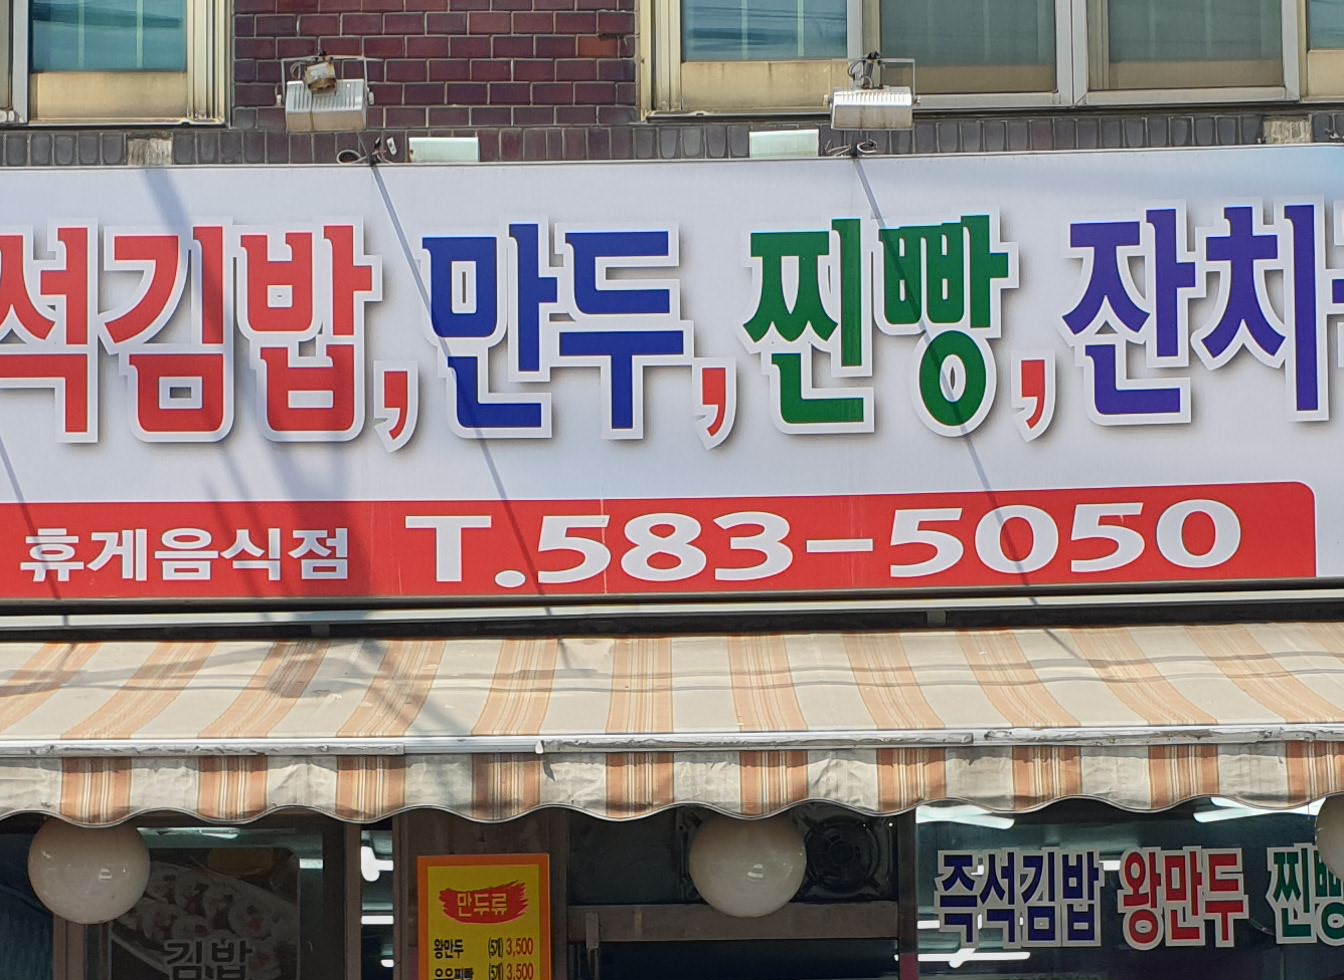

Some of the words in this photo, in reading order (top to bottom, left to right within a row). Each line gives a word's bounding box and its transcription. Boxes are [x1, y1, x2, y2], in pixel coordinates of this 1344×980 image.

[19, 525, 350, 585] 휴게음식점
[456, 891, 508, 917] 만두류
[939, 850, 1100, 944] 즉석김밥
[1122, 850, 1246, 946] 왕만두
[434, 939, 464, 959] 왕만두
[506, 938, 534, 956] 3,500
[506, 963, 534, 980] 3,500
